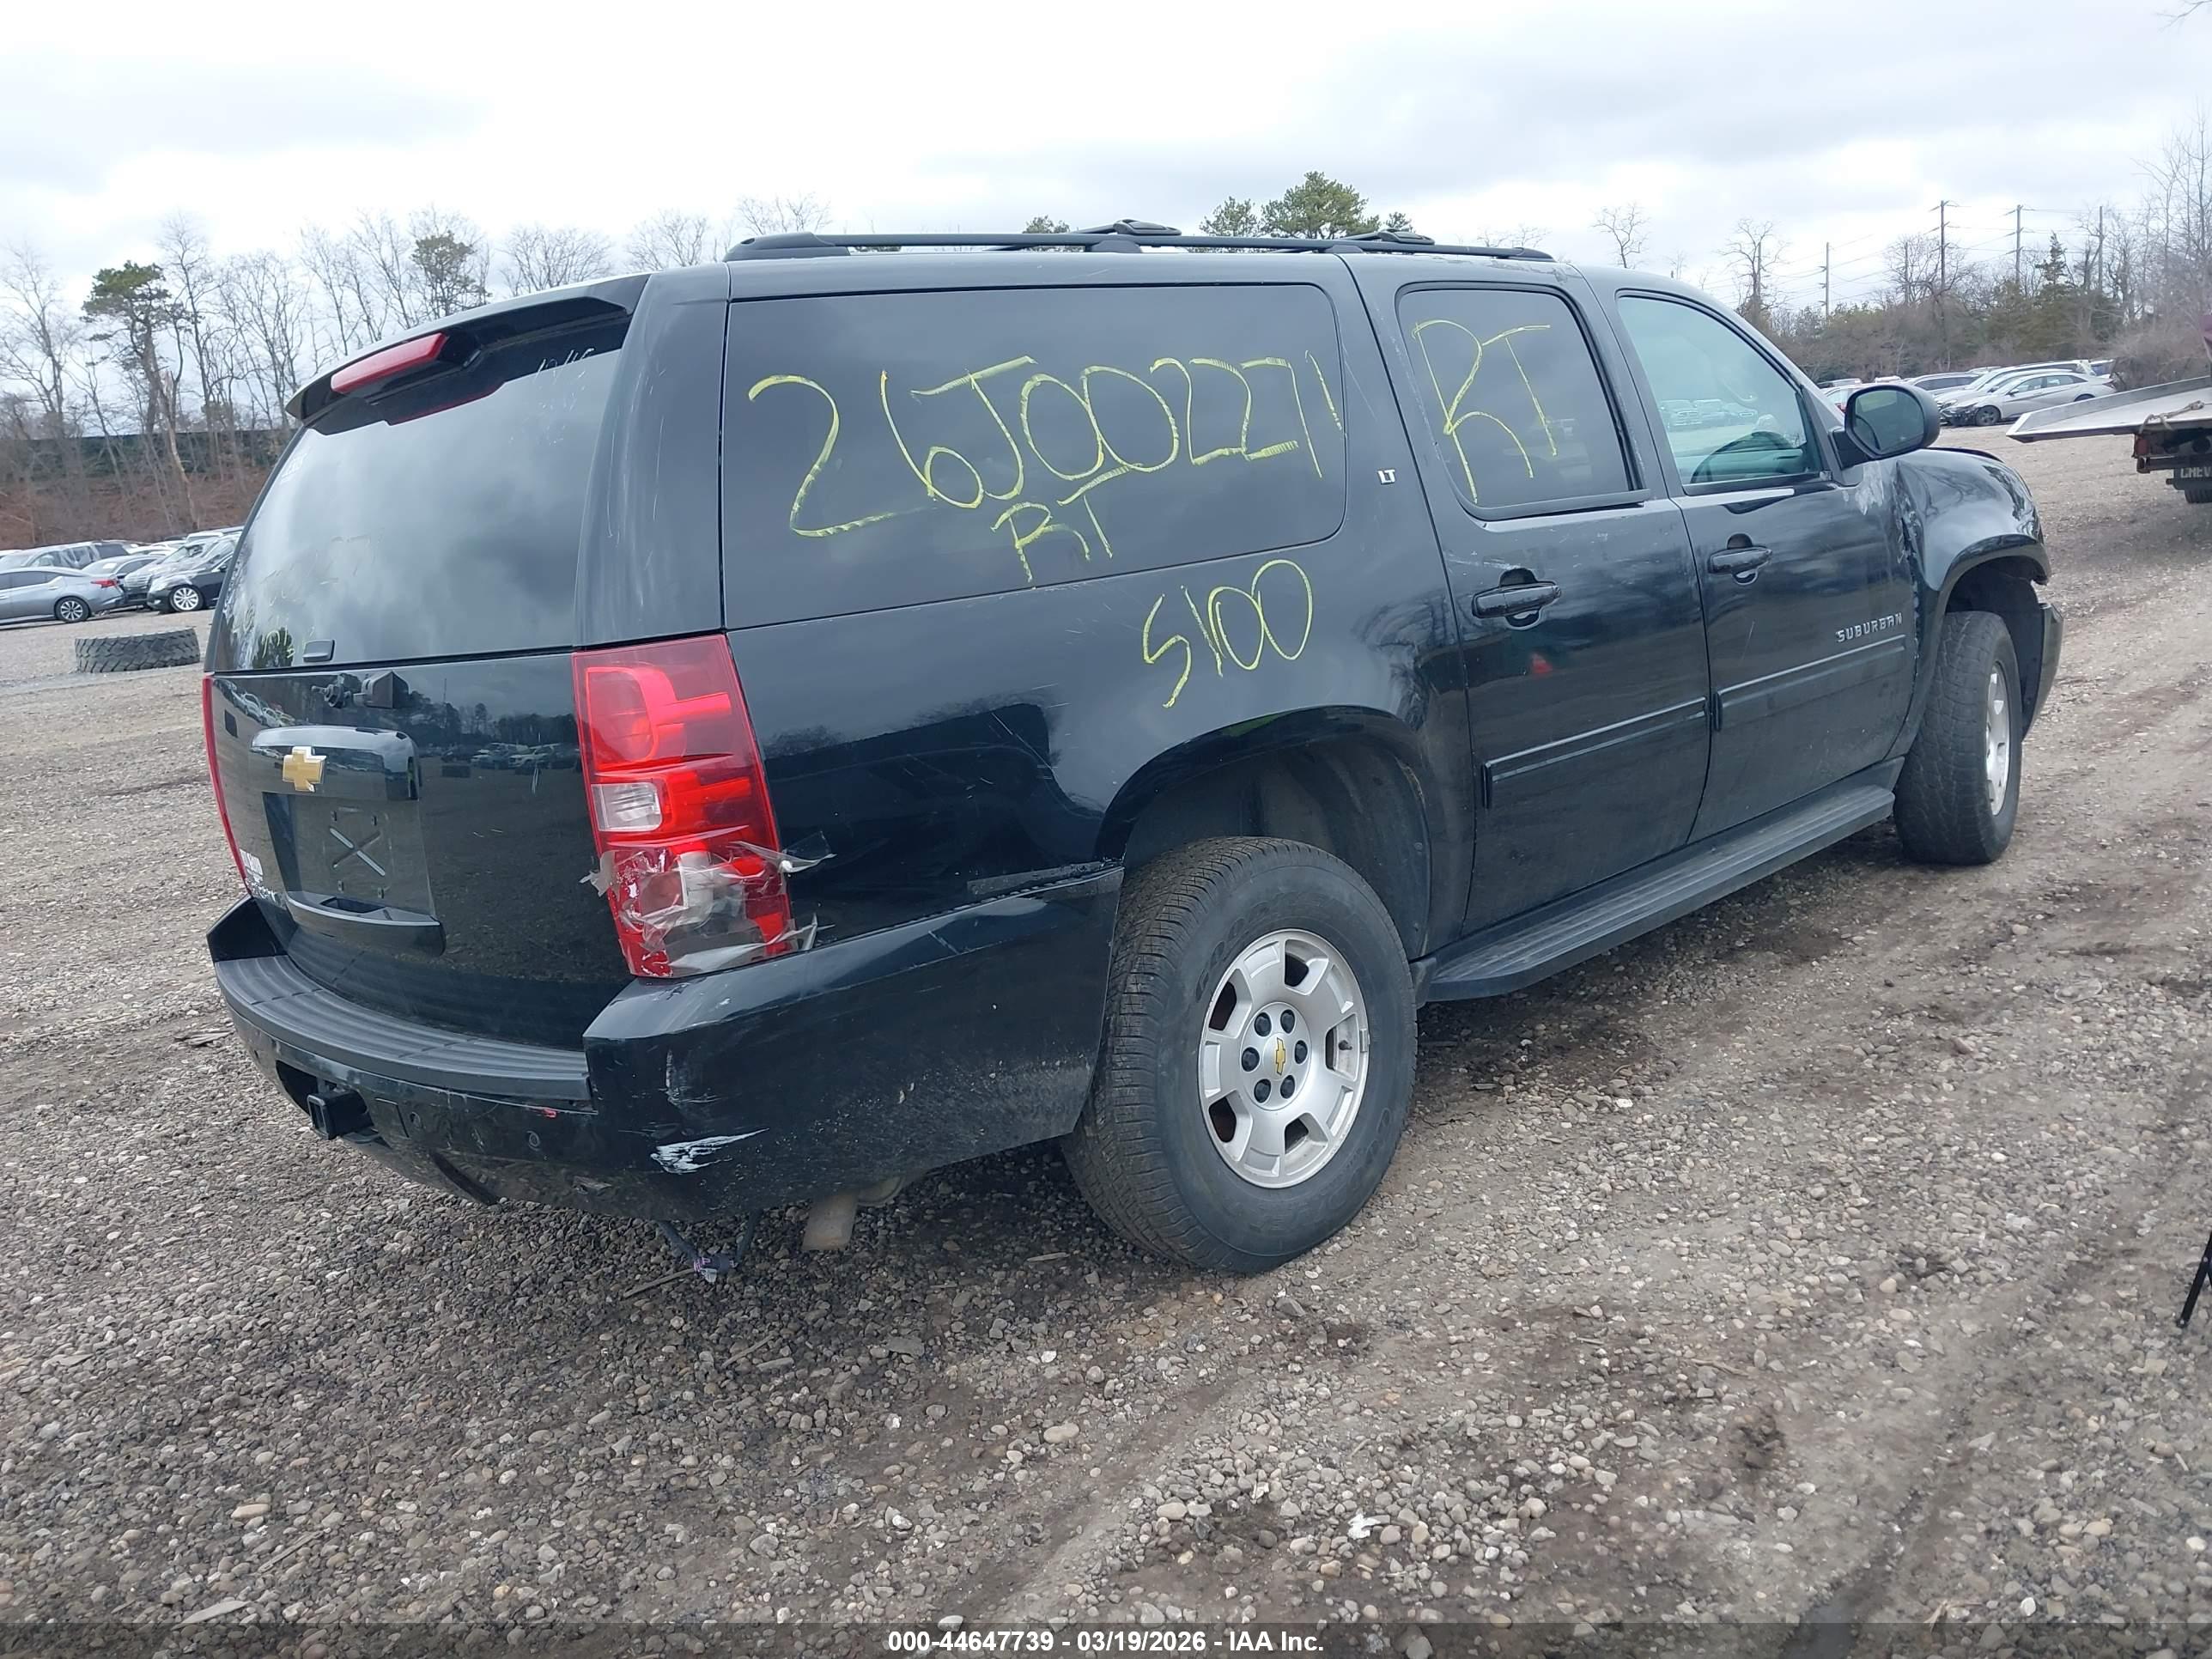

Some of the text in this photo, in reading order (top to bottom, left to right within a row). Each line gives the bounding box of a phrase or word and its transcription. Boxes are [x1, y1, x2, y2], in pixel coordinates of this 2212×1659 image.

[1411, 319, 1558, 504] RT
[1377, 469, 1395, 484] LT
[989, 462, 1141, 584] RT
[1835, 611, 1903, 643] SUBURBAN
